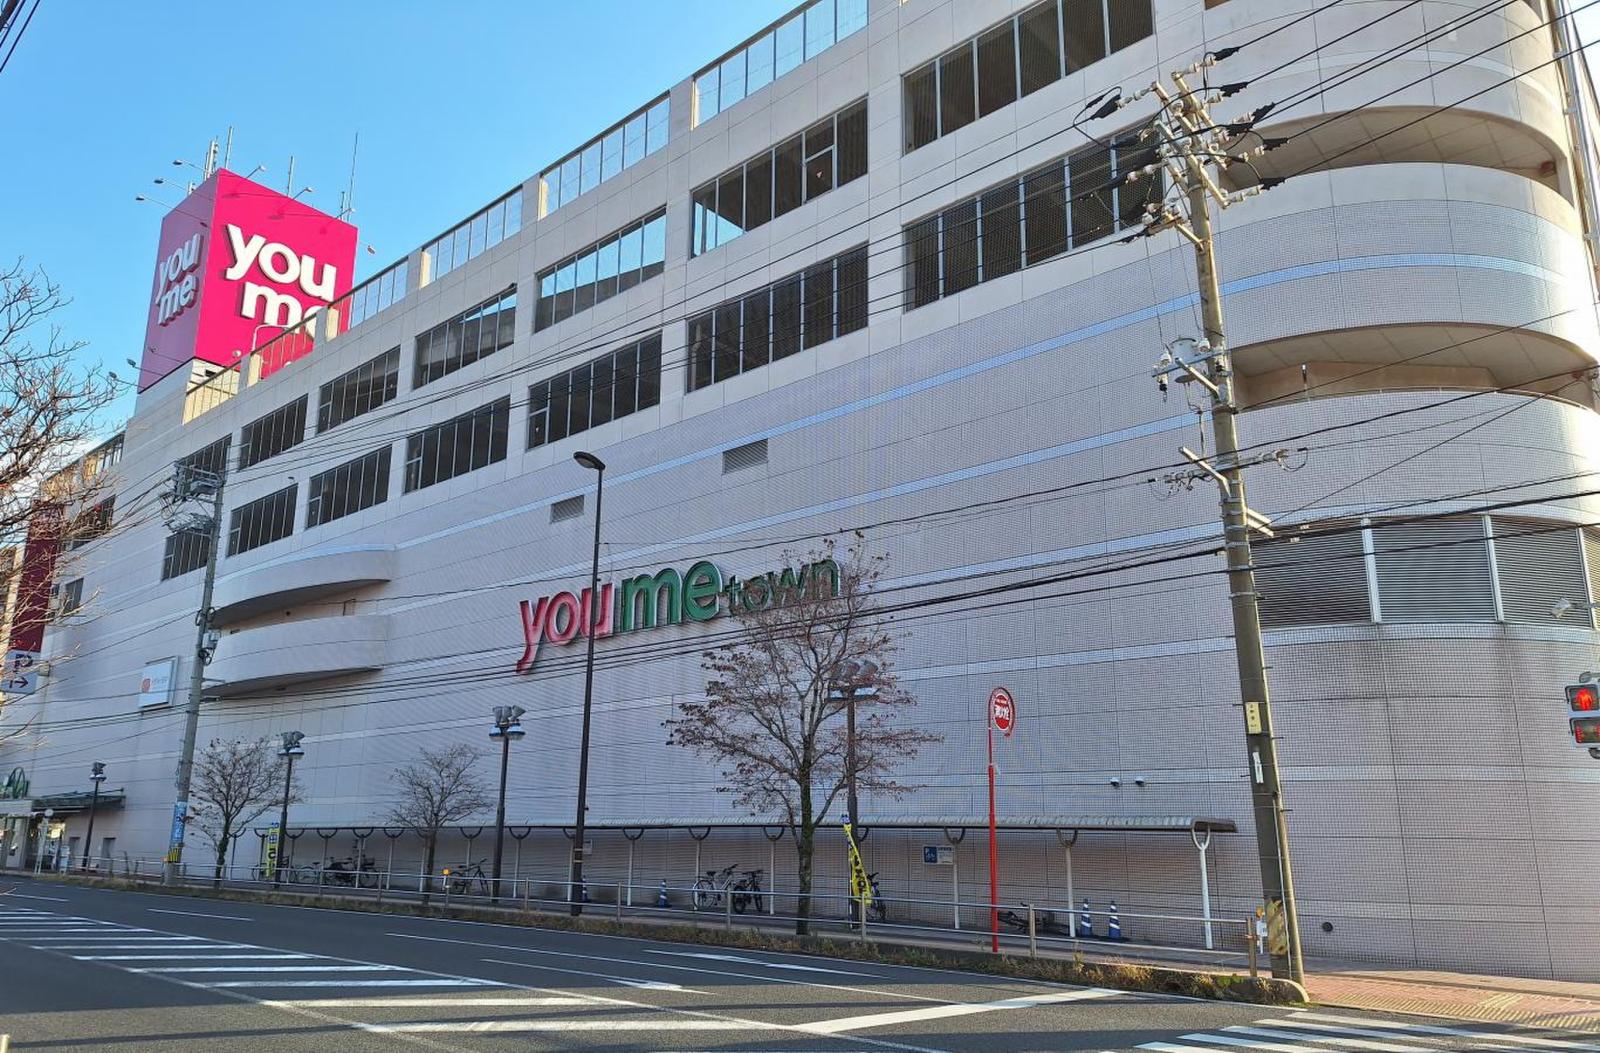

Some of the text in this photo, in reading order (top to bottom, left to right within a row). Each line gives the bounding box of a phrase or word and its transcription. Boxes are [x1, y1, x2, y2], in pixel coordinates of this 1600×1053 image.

[155, 233, 201, 304] you
[225, 223, 337, 303] you
[157, 274, 197, 326] me
[723, 558, 841, 617] town
